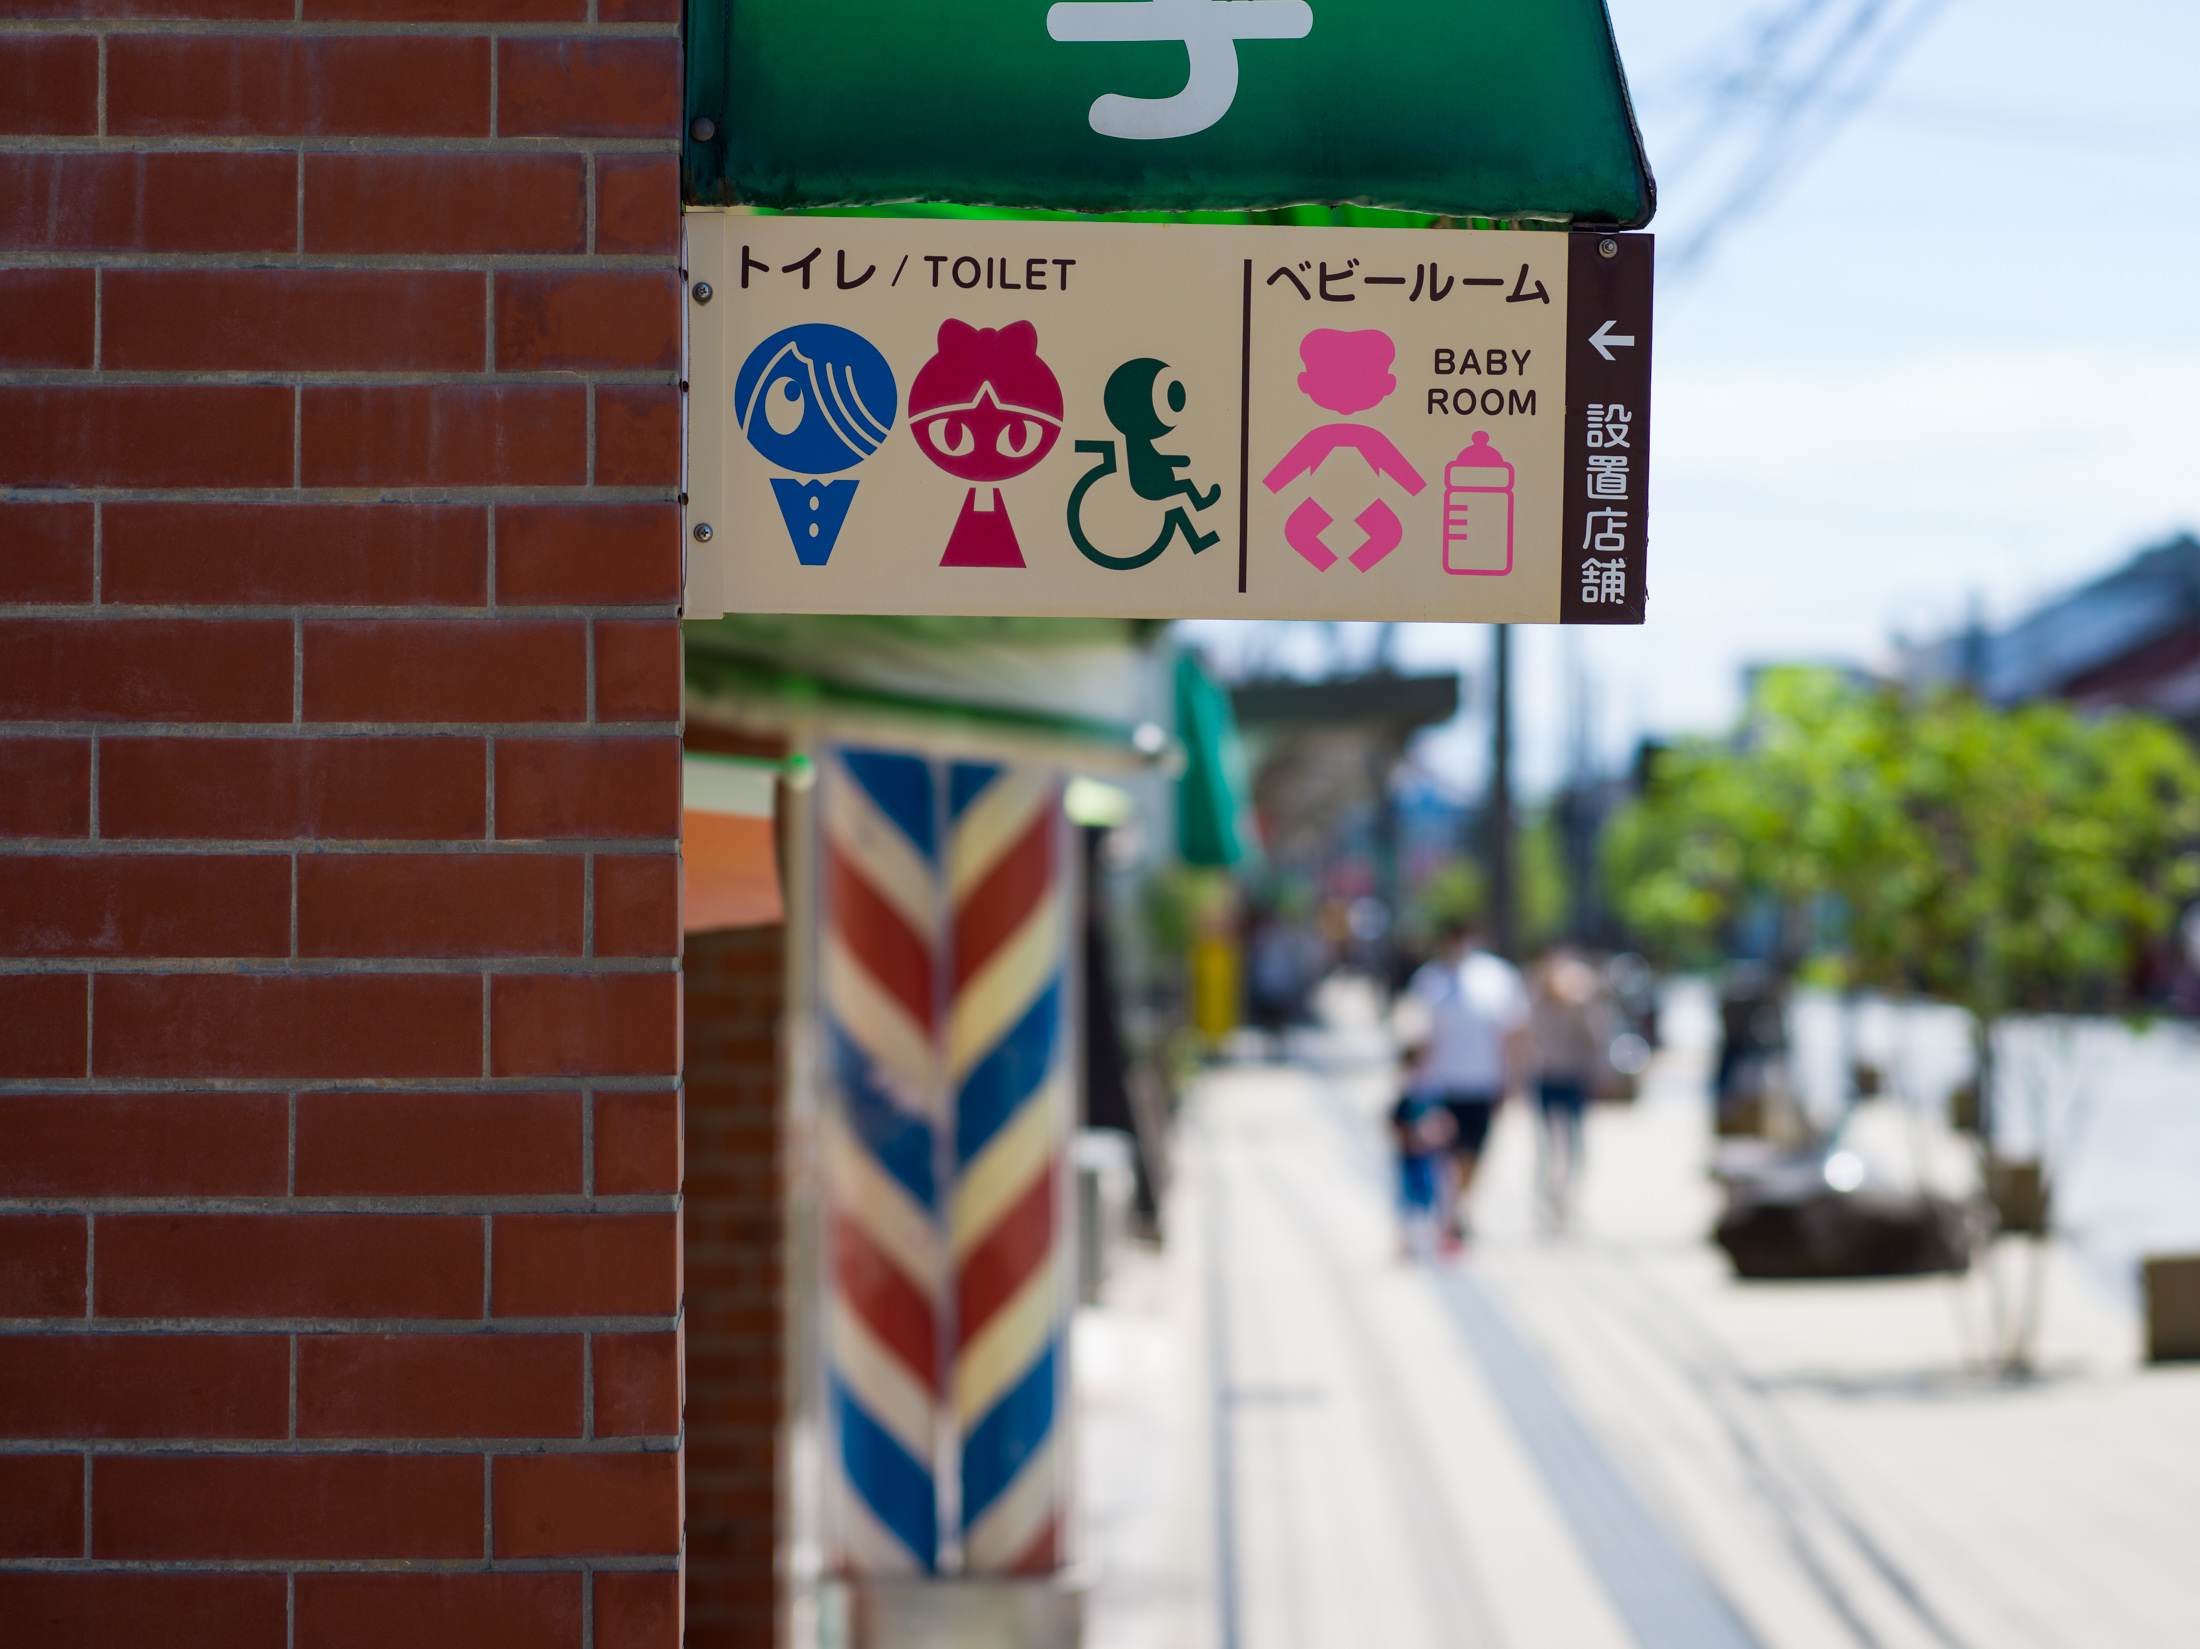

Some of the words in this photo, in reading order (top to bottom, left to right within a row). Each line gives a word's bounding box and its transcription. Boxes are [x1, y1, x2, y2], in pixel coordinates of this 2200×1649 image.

[740, 245, 876, 290] トイレ
[890, 254, 909, 287] /
[923, 255, 1077, 292] TOILET
[1266, 257, 1551, 305] ベビールーム
[1433, 347, 1532, 377] BABY
[1427, 387, 1537, 417] ROOM
[1580, 403, 1633, 605] 設置店舗
